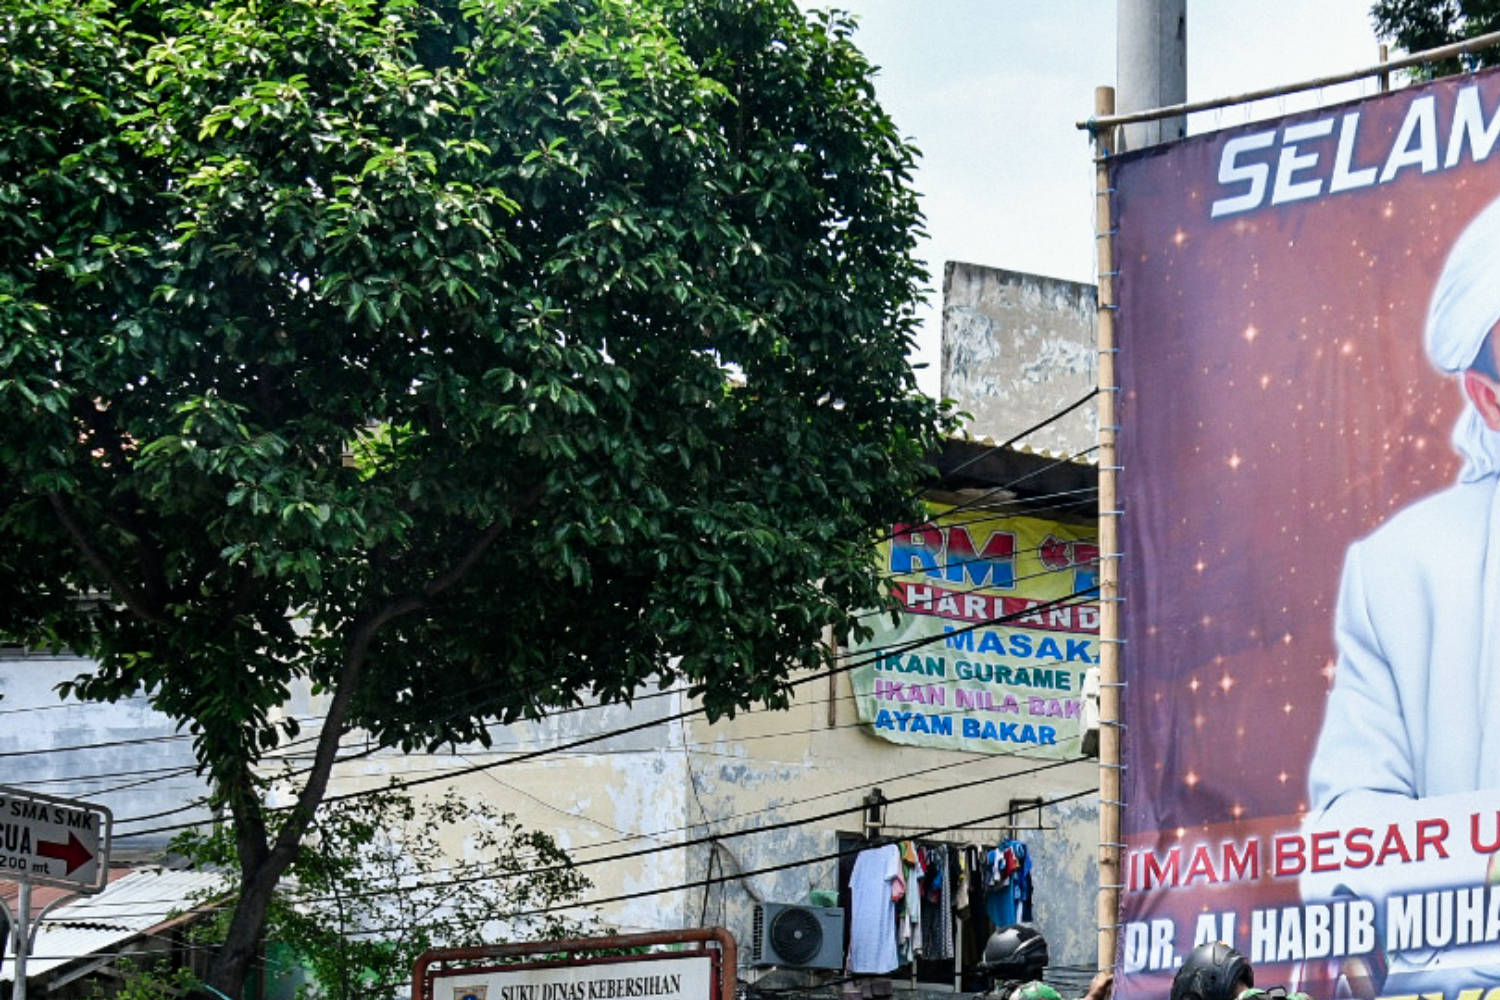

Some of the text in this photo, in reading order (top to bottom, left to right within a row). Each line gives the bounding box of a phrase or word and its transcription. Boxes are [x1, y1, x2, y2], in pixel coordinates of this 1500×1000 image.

[889, 520, 1017, 590] RM
[944, 625, 1100, 664] MASAK
[875, 651, 1071, 690] IKAN GURAME
[875, 679, 1082, 719] IKAN NILA BAK
[875, 708, 1057, 746] AYAM BAKAR
[11, 801, 93, 830] SMA SMK
[1128, 840, 1260, 893] IMAM
[1274, 817, 1450, 877] BESAR
[1123, 915, 1184, 975] DR.
[1251, 898, 1377, 965] HABIB
[588, 974, 681, 1000] KEBERSIHAN
